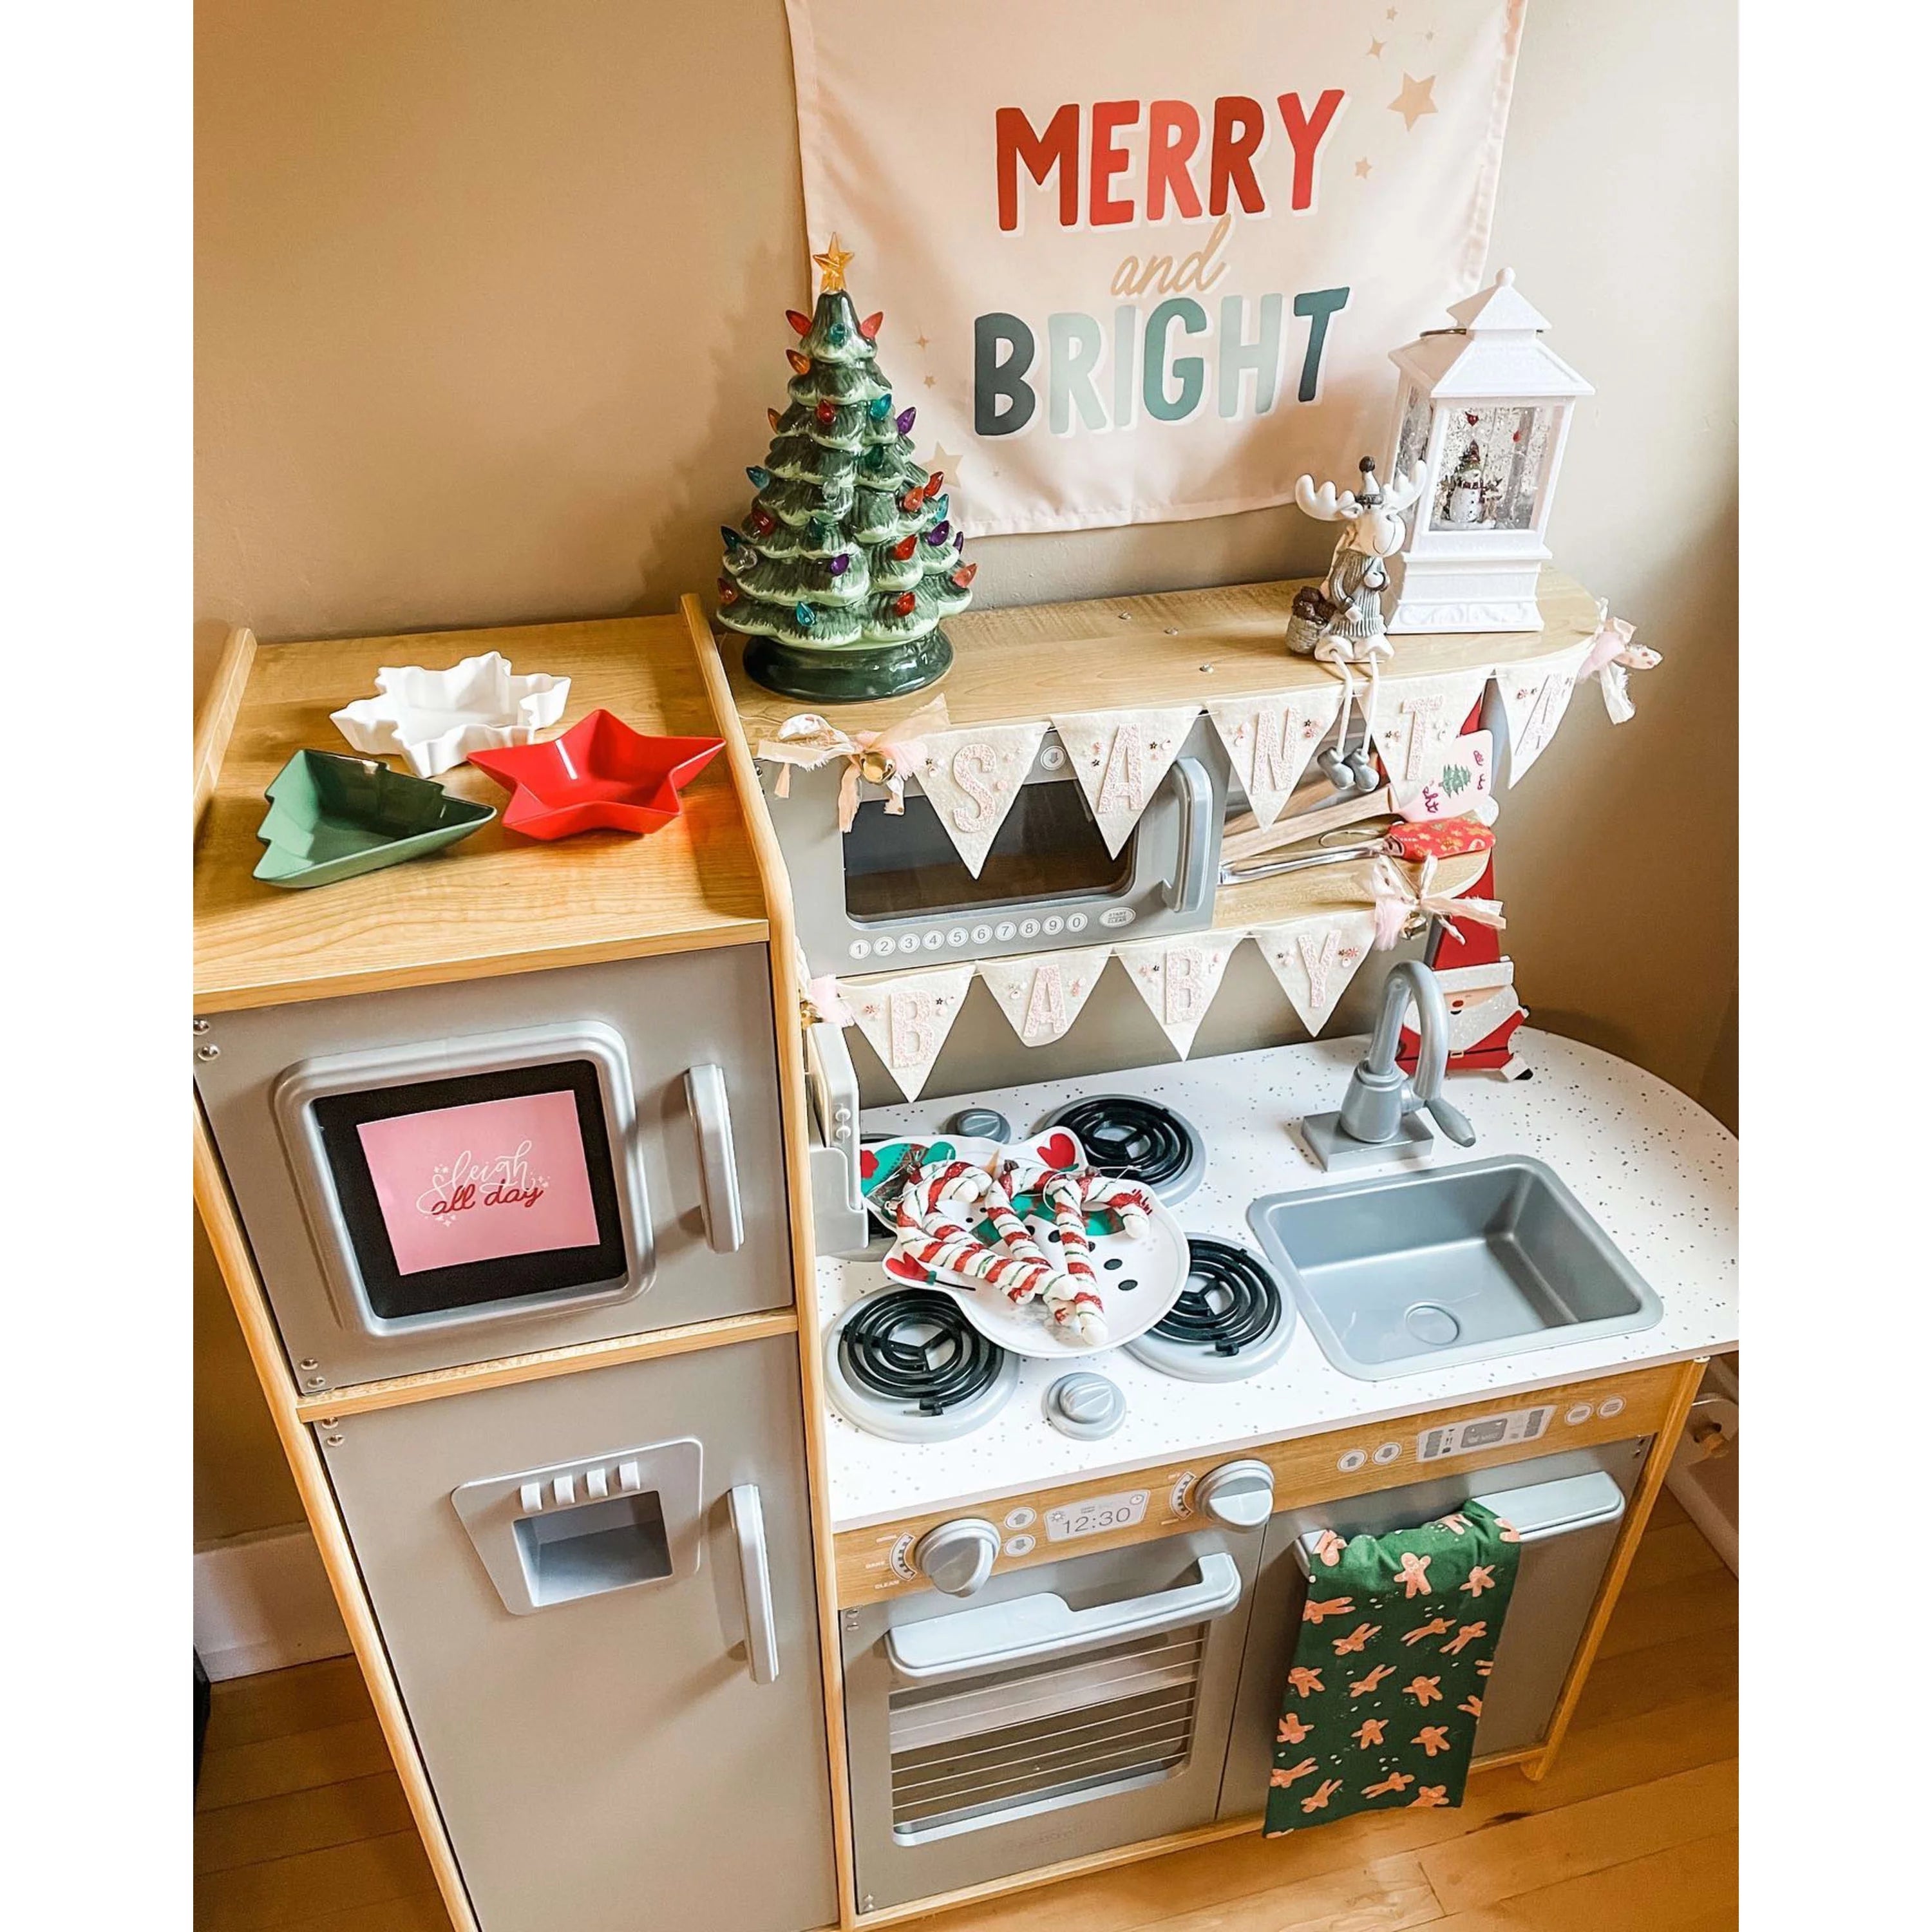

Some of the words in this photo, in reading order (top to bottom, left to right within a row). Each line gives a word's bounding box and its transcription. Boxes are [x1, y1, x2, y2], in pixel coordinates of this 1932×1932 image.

[996, 89, 1345, 231] MERRY
[1111, 214, 1231, 296] and
[974, 287, 1350, 435] BRIGHT
[953, 674, 1574, 832] SANTA
[856, 945, 862, 954] 1
[880, 942, 888, 952] 2
[905, 938, 913, 949] 3
[930, 935, 937, 945] 4
[954, 931, 961, 942] 5
[978, 929, 985, 939] 6
[1002, 926, 1009, 936] 7
[1025, 923, 1033, 933] 8
[1049, 920, 1057, 931] 9
[1073, 917, 1081, 927] 0
[891, 931, 1340, 1069] BABY
[416, 1140, 535, 1214] sleigh
[431, 1183, 475, 1215] all
[484, 1179, 544, 1208] day
[1064, 1508, 1131, 1533] 12:30
